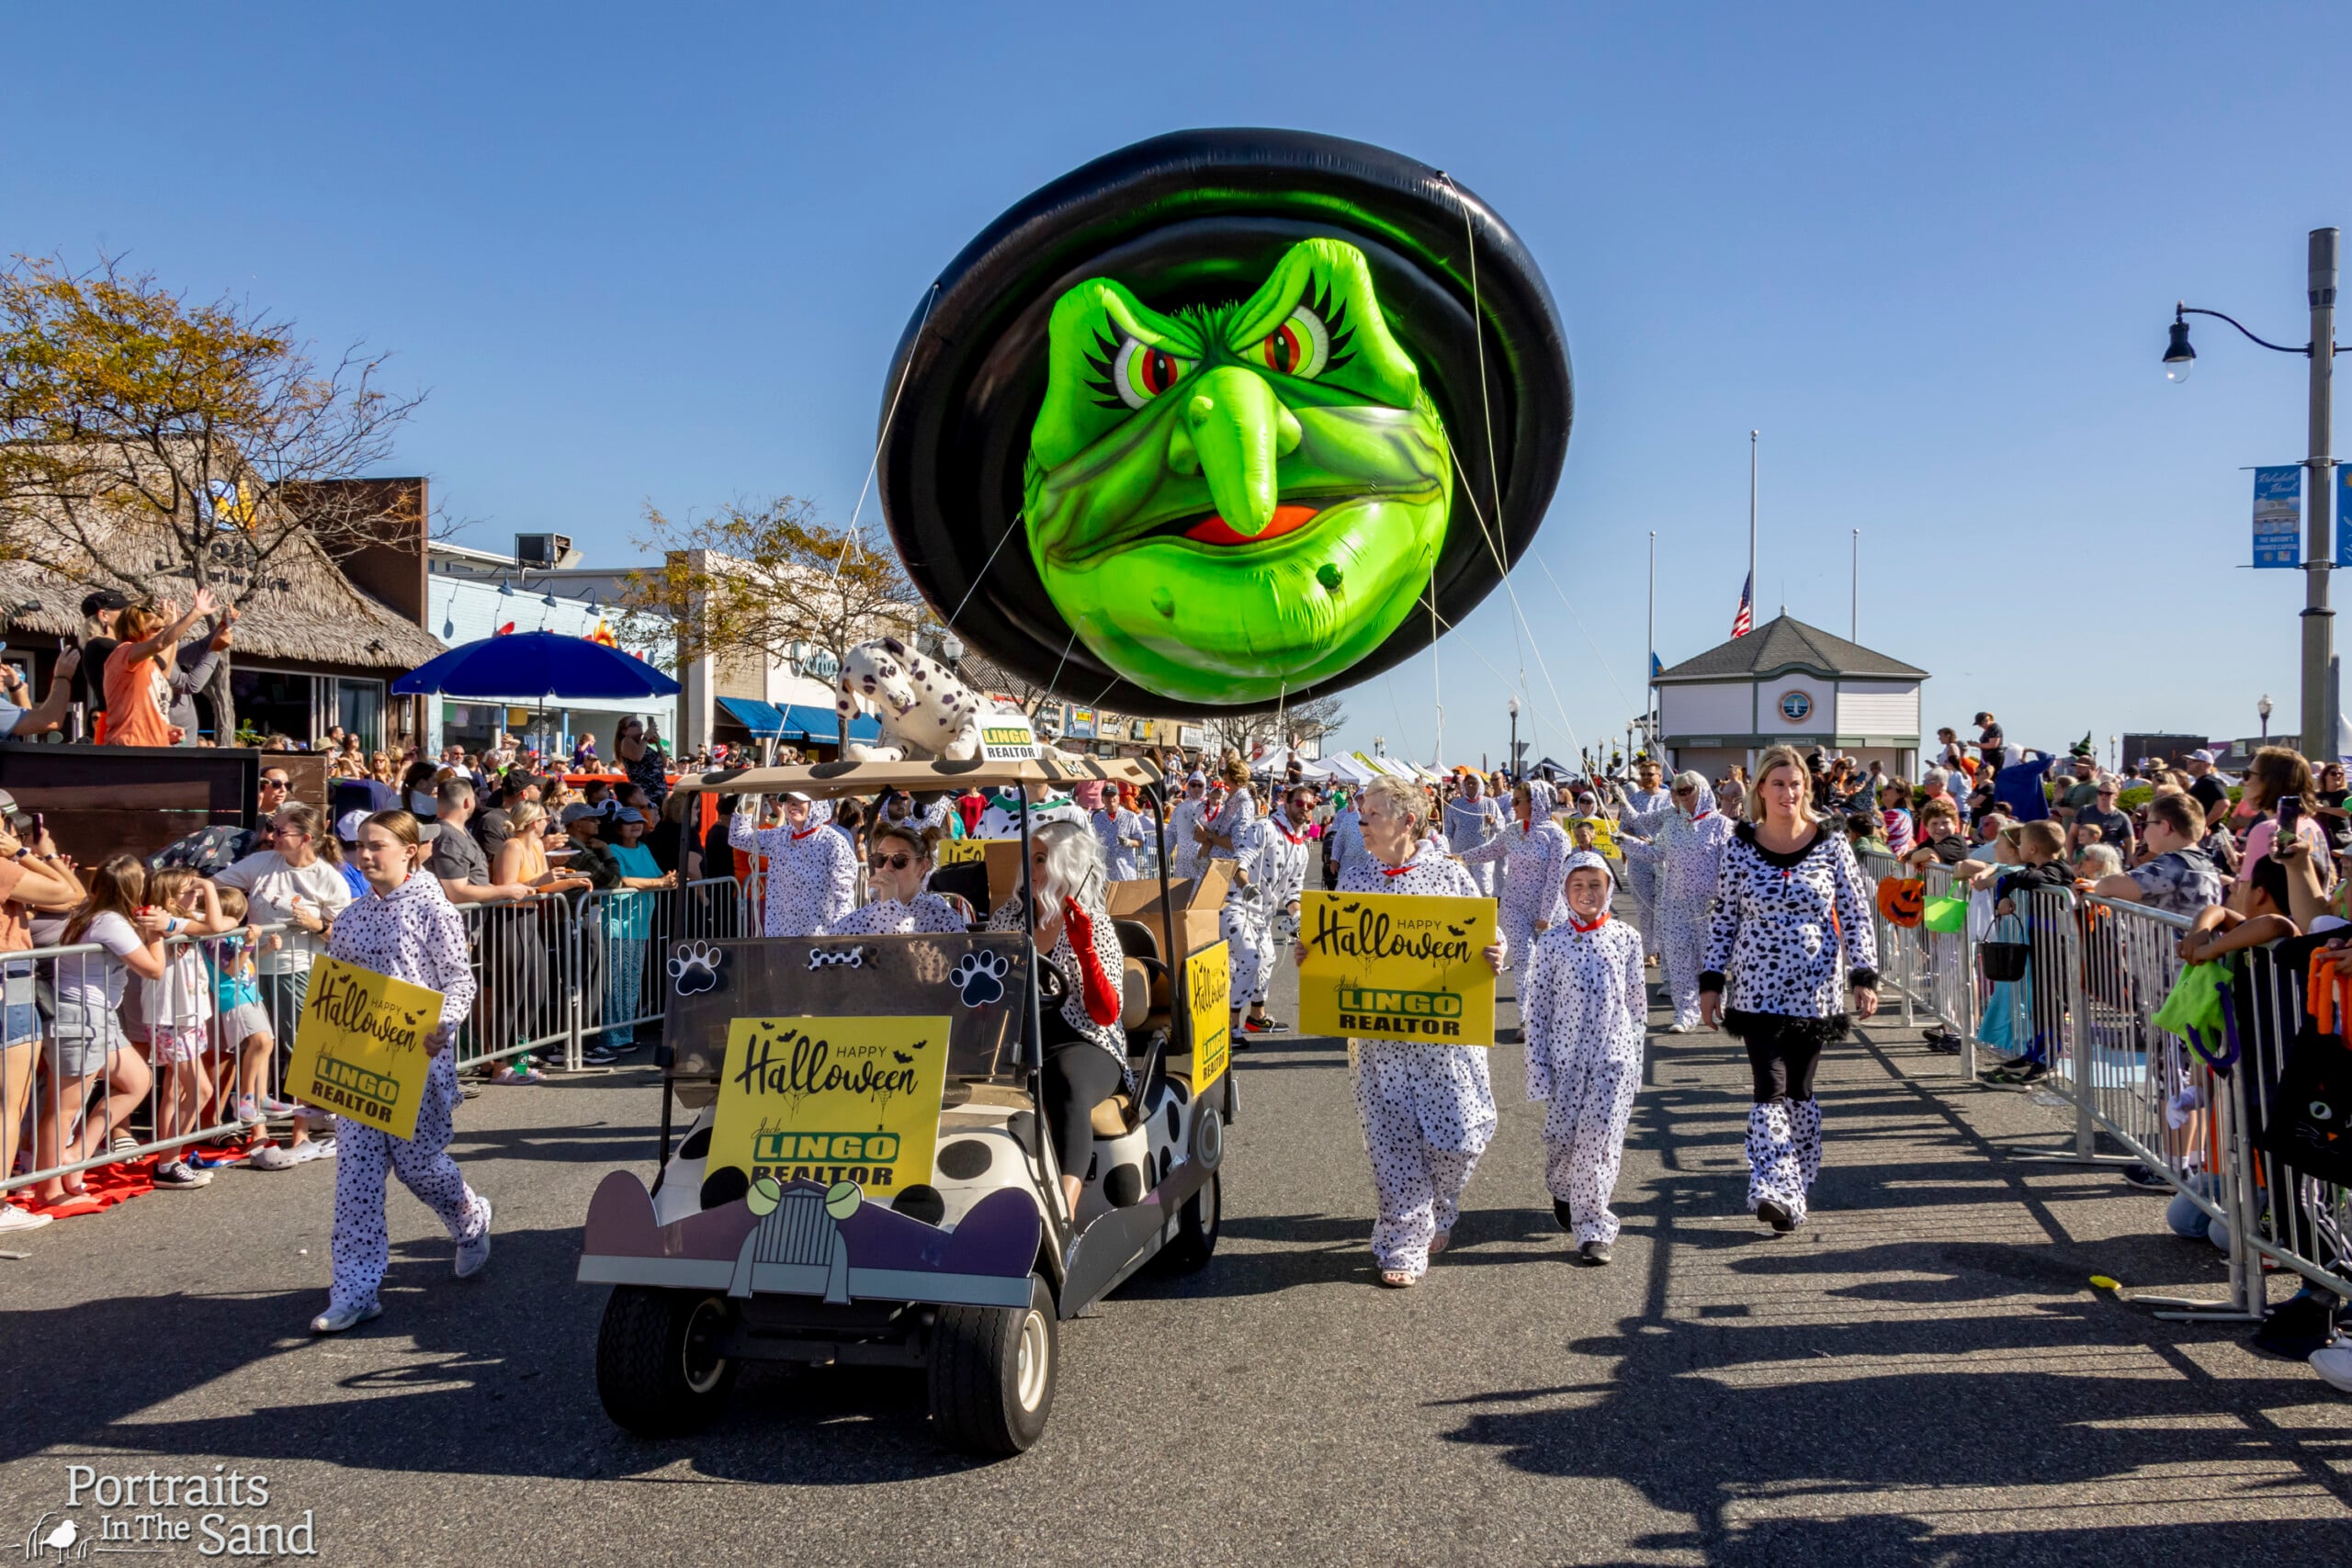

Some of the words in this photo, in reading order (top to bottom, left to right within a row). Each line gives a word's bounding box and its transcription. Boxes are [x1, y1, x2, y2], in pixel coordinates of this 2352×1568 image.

[982, 728, 1032, 744] LINGO
[987, 747, 1036, 758] REALTOR
[1311, 904, 1472, 964] Halloween
[1397, 919, 1442, 931] HAPPY
[311, 970, 417, 1053] Halloween
[371, 998, 402, 1015] HAPPY
[1341, 991, 1460, 1015] LINGO
[1340, 1014, 1460, 1036] REALTOR
[836, 1045, 888, 1058] HAPPY
[734, 1033, 919, 1095] Halloween
[1203, 1052, 1226, 1081] REALTOR
[317, 1057, 398, 1103] LINGO
[311, 1079, 393, 1123] REALTOR
[751, 1117, 781, 1139] Jack
[756, 1135, 899, 1161] LINGO
[751, 1166, 894, 1186] REALTOR
